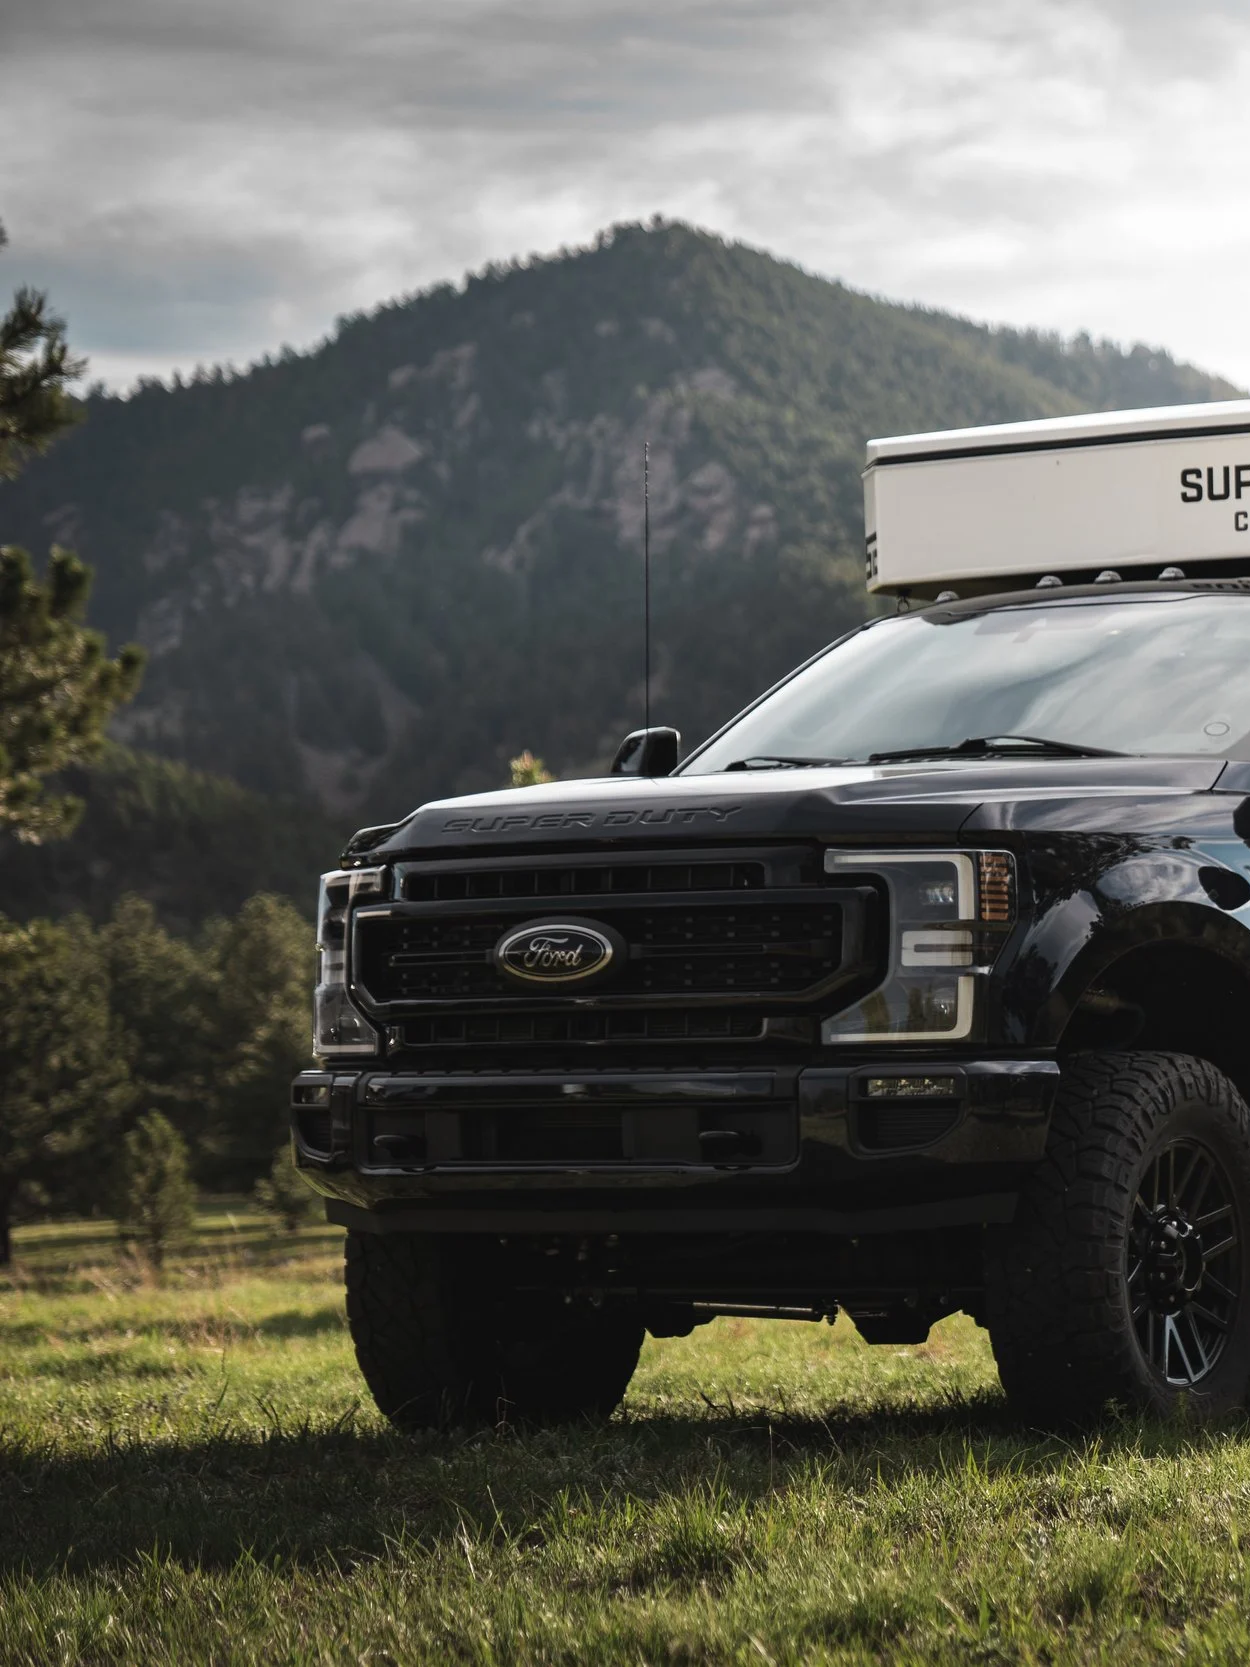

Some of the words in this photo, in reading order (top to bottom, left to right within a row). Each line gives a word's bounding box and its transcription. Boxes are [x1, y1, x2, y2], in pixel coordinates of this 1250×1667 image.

[442, 812, 597, 833] SUPER
[602, 806, 743, 828] DUTY
[524, 937, 584, 967] Ford
